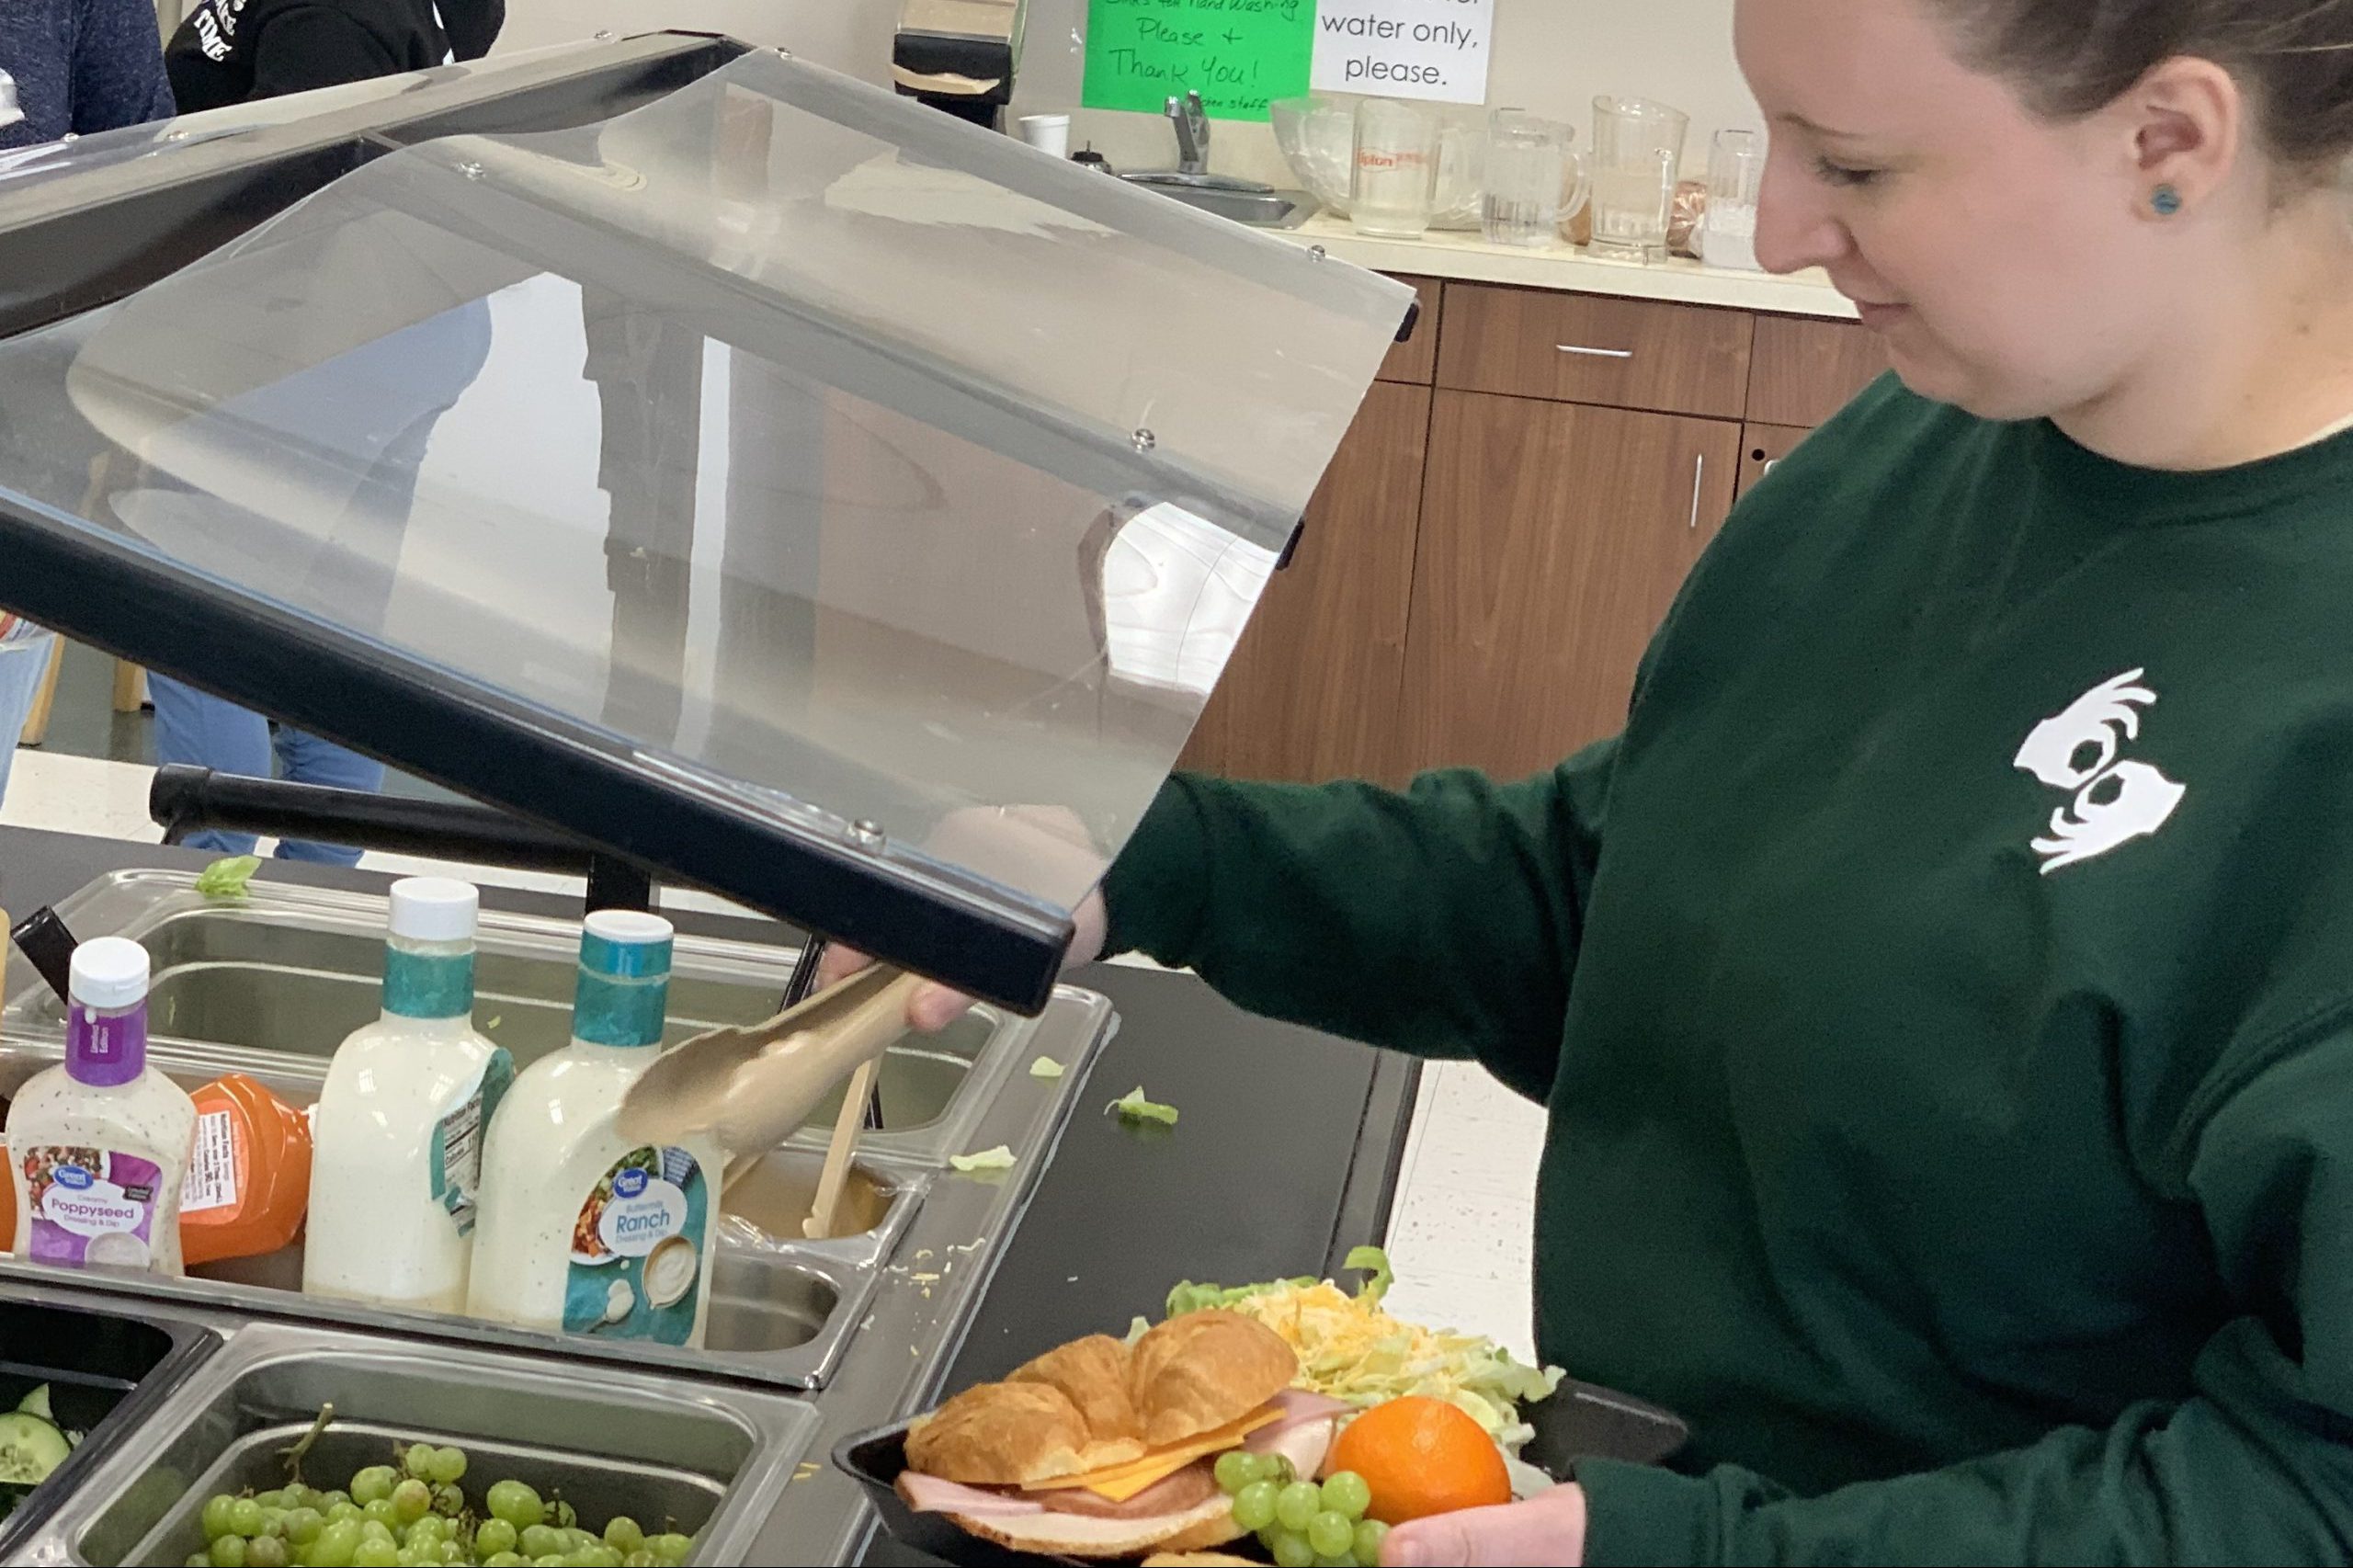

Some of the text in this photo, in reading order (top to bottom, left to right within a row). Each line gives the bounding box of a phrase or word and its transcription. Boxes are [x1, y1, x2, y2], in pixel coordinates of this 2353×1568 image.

[193, 8, 233, 62] TIME
[1136, 17, 1204, 46] Please
[1322, 14, 1478, 50] water only,
[1200, 56, 1258, 88] You!
[1345, 55, 1447, 85] please.
[51, 1198, 134, 1219] Poppyseed
[617, 1210, 670, 1233] Ranch
